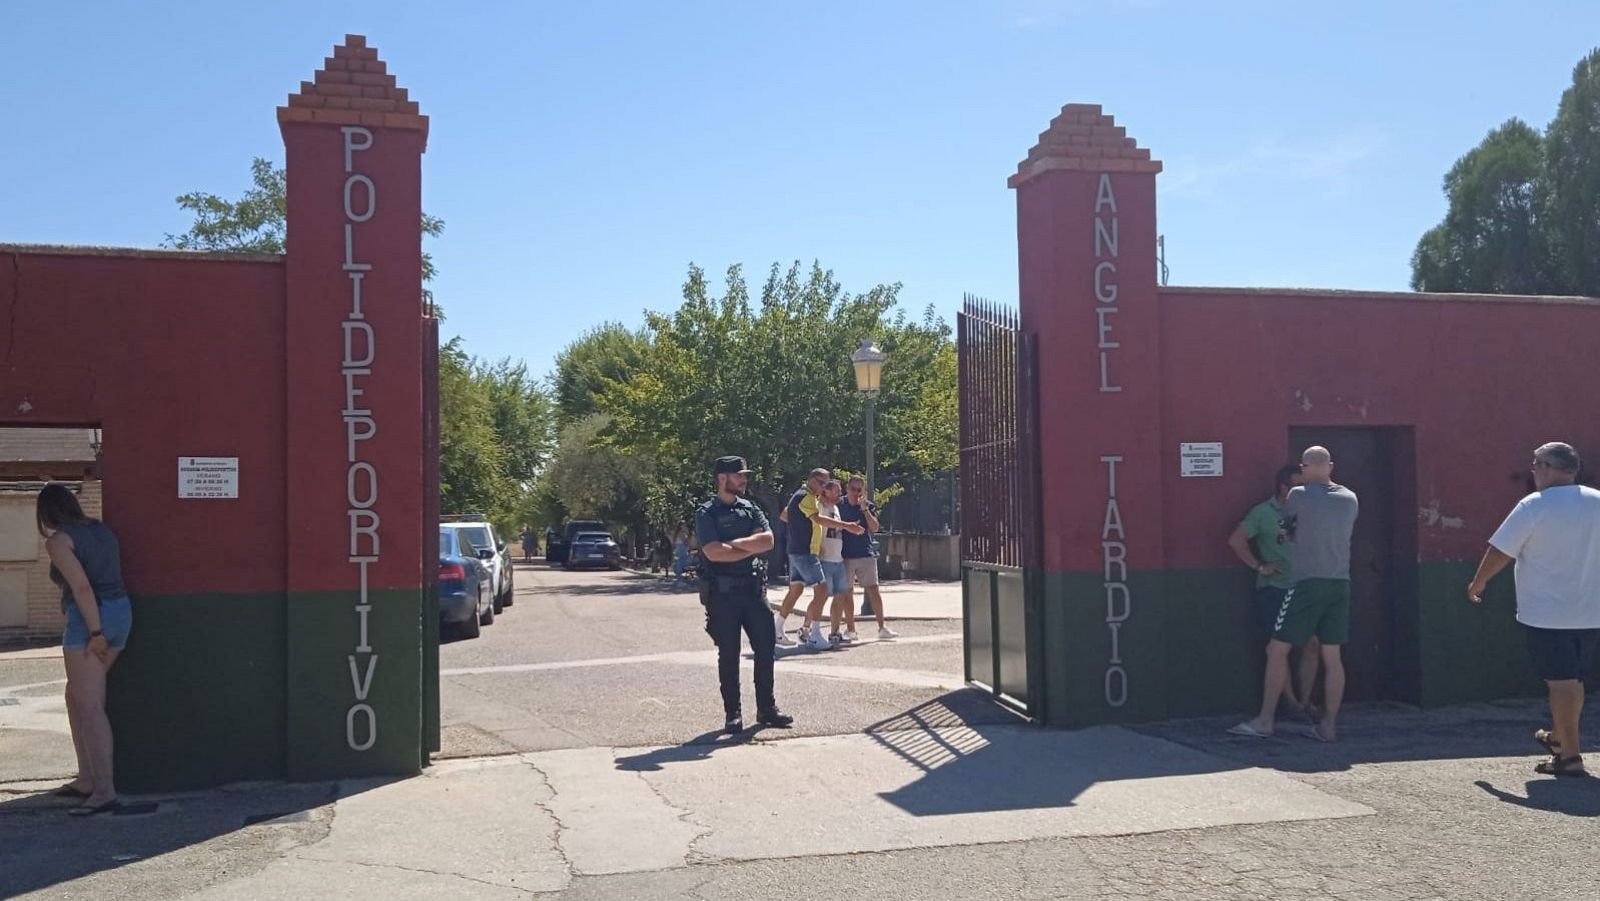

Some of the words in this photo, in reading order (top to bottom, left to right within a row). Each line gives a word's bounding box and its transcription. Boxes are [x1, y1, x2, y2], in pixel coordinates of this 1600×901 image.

[1094, 174, 1122, 392] ANGEL
[341, 126, 380, 751] POLIDEPORTIVO
[1101, 456, 1130, 706] TARDIO
